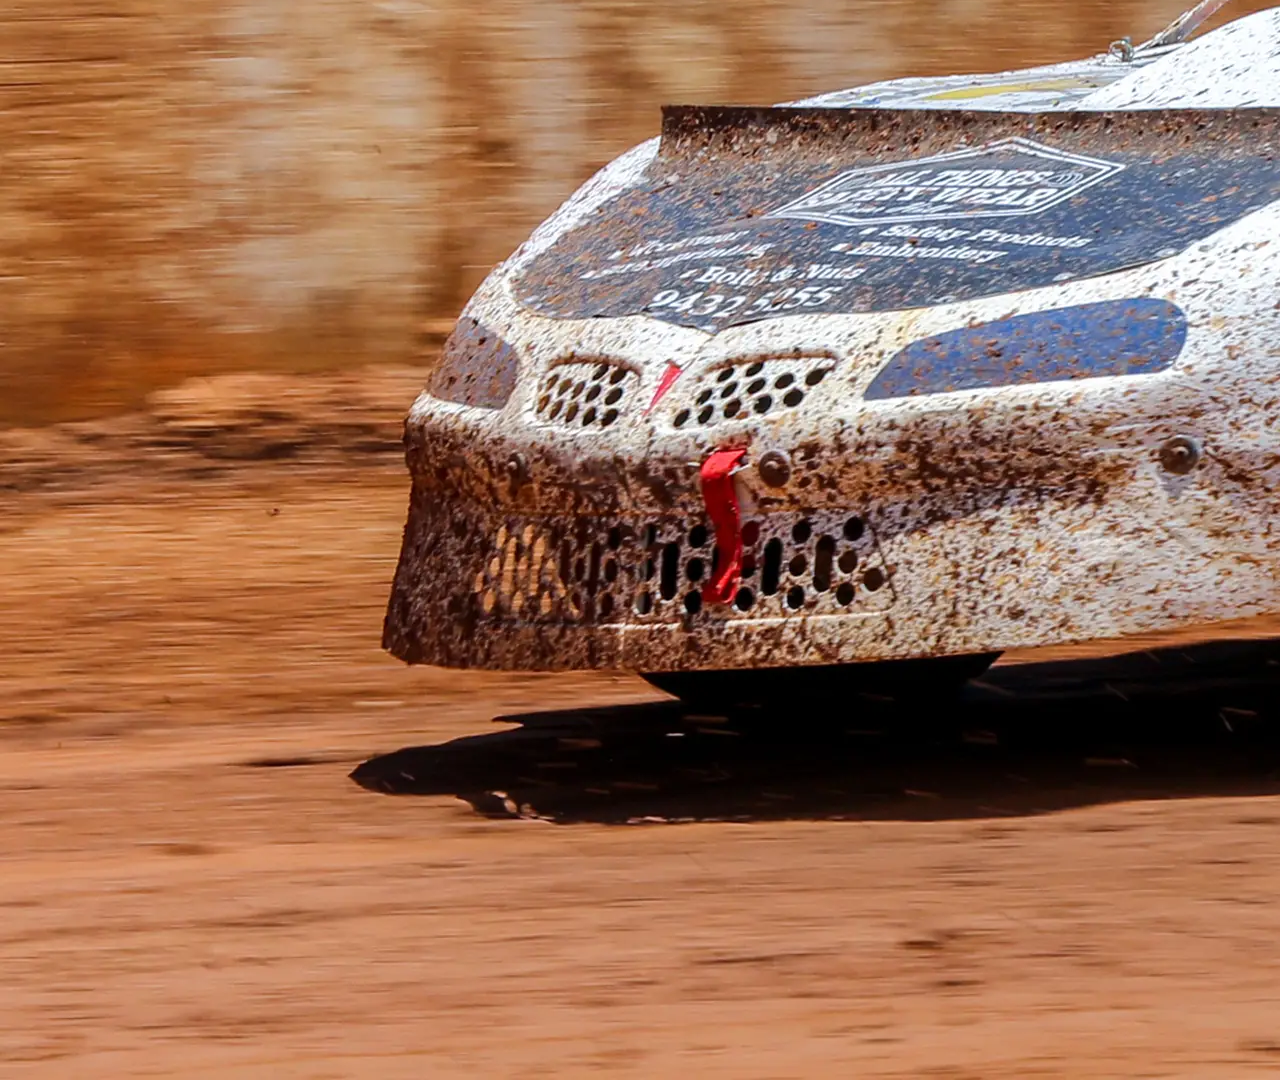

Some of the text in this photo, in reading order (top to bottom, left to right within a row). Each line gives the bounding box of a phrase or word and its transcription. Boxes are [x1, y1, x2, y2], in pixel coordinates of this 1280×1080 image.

[865, 168, 1056, 188] ALL THINGS
[929, 187, 1060, 206] WEAR
[879, 224, 1093, 249] Safety Products
[845, 241, 1009, 264] Embroidery
[796, 263, 867, 280] Nuts
[648, 289, 747, 318] 9432
